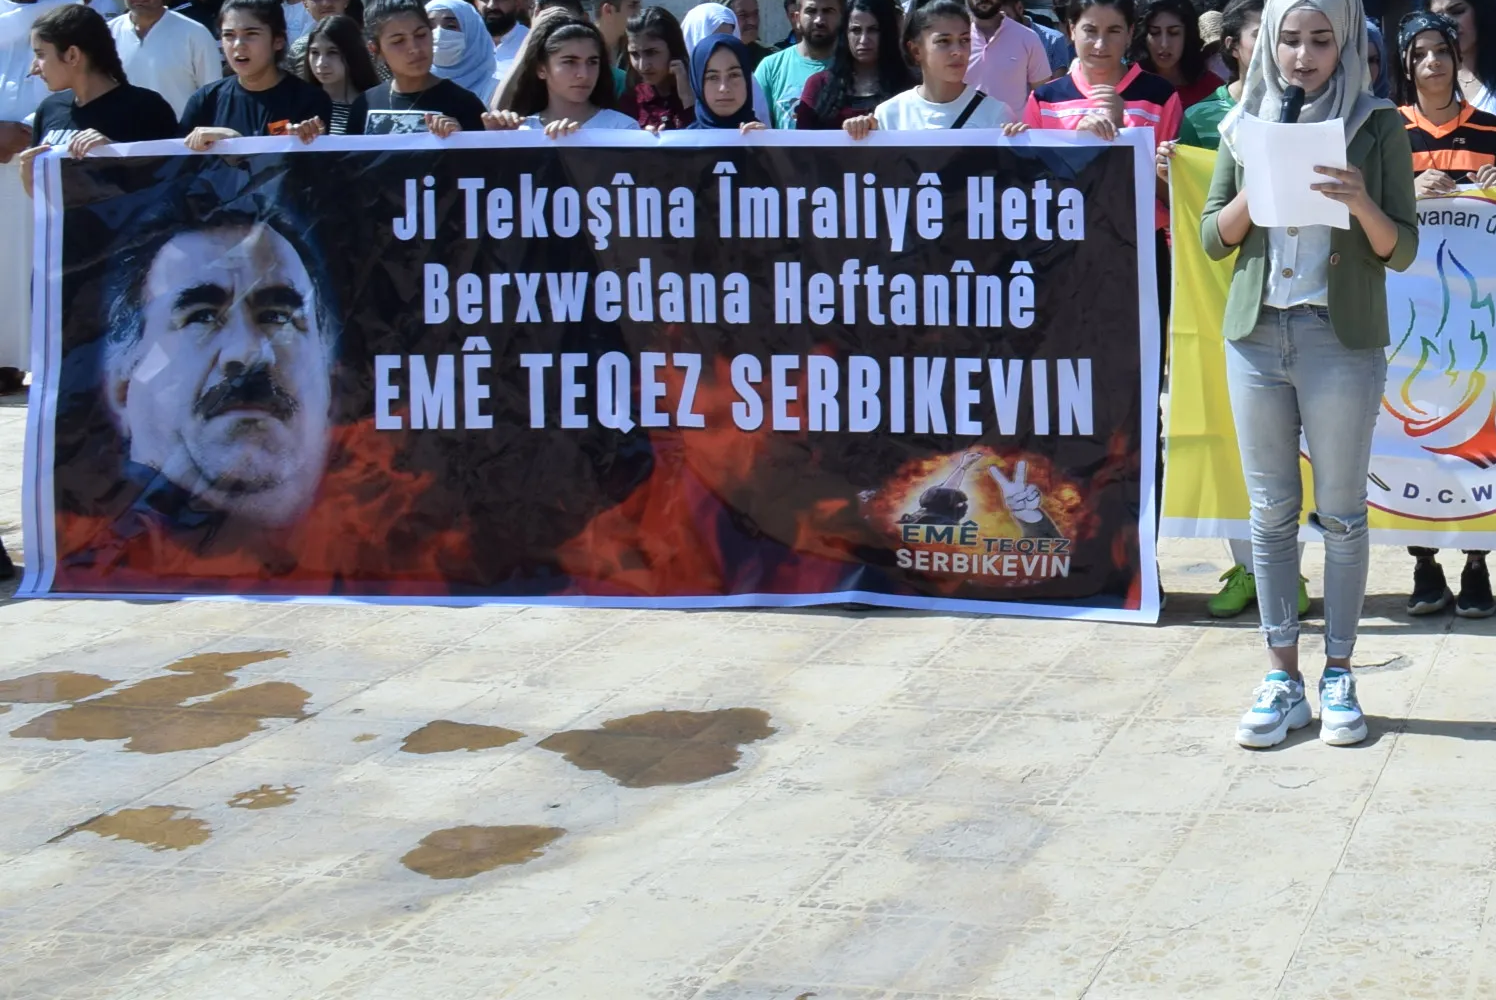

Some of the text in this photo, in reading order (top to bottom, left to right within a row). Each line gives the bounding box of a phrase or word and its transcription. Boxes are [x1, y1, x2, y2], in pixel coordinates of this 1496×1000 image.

[392, 161, 1085, 252] Ji Tekoşîna Îmraliyê Heta
[1415, 209, 1480, 229] wanan
[423, 258, 1036, 329] Berxwedana Heftanînê
[373, 337, 1094, 437] EMÊ TEQEZ SERBIKEVIN
[895, 549, 1071, 578] SERBIKEVIN
[902, 520, 1071, 555] EMÊ TEQEZ
